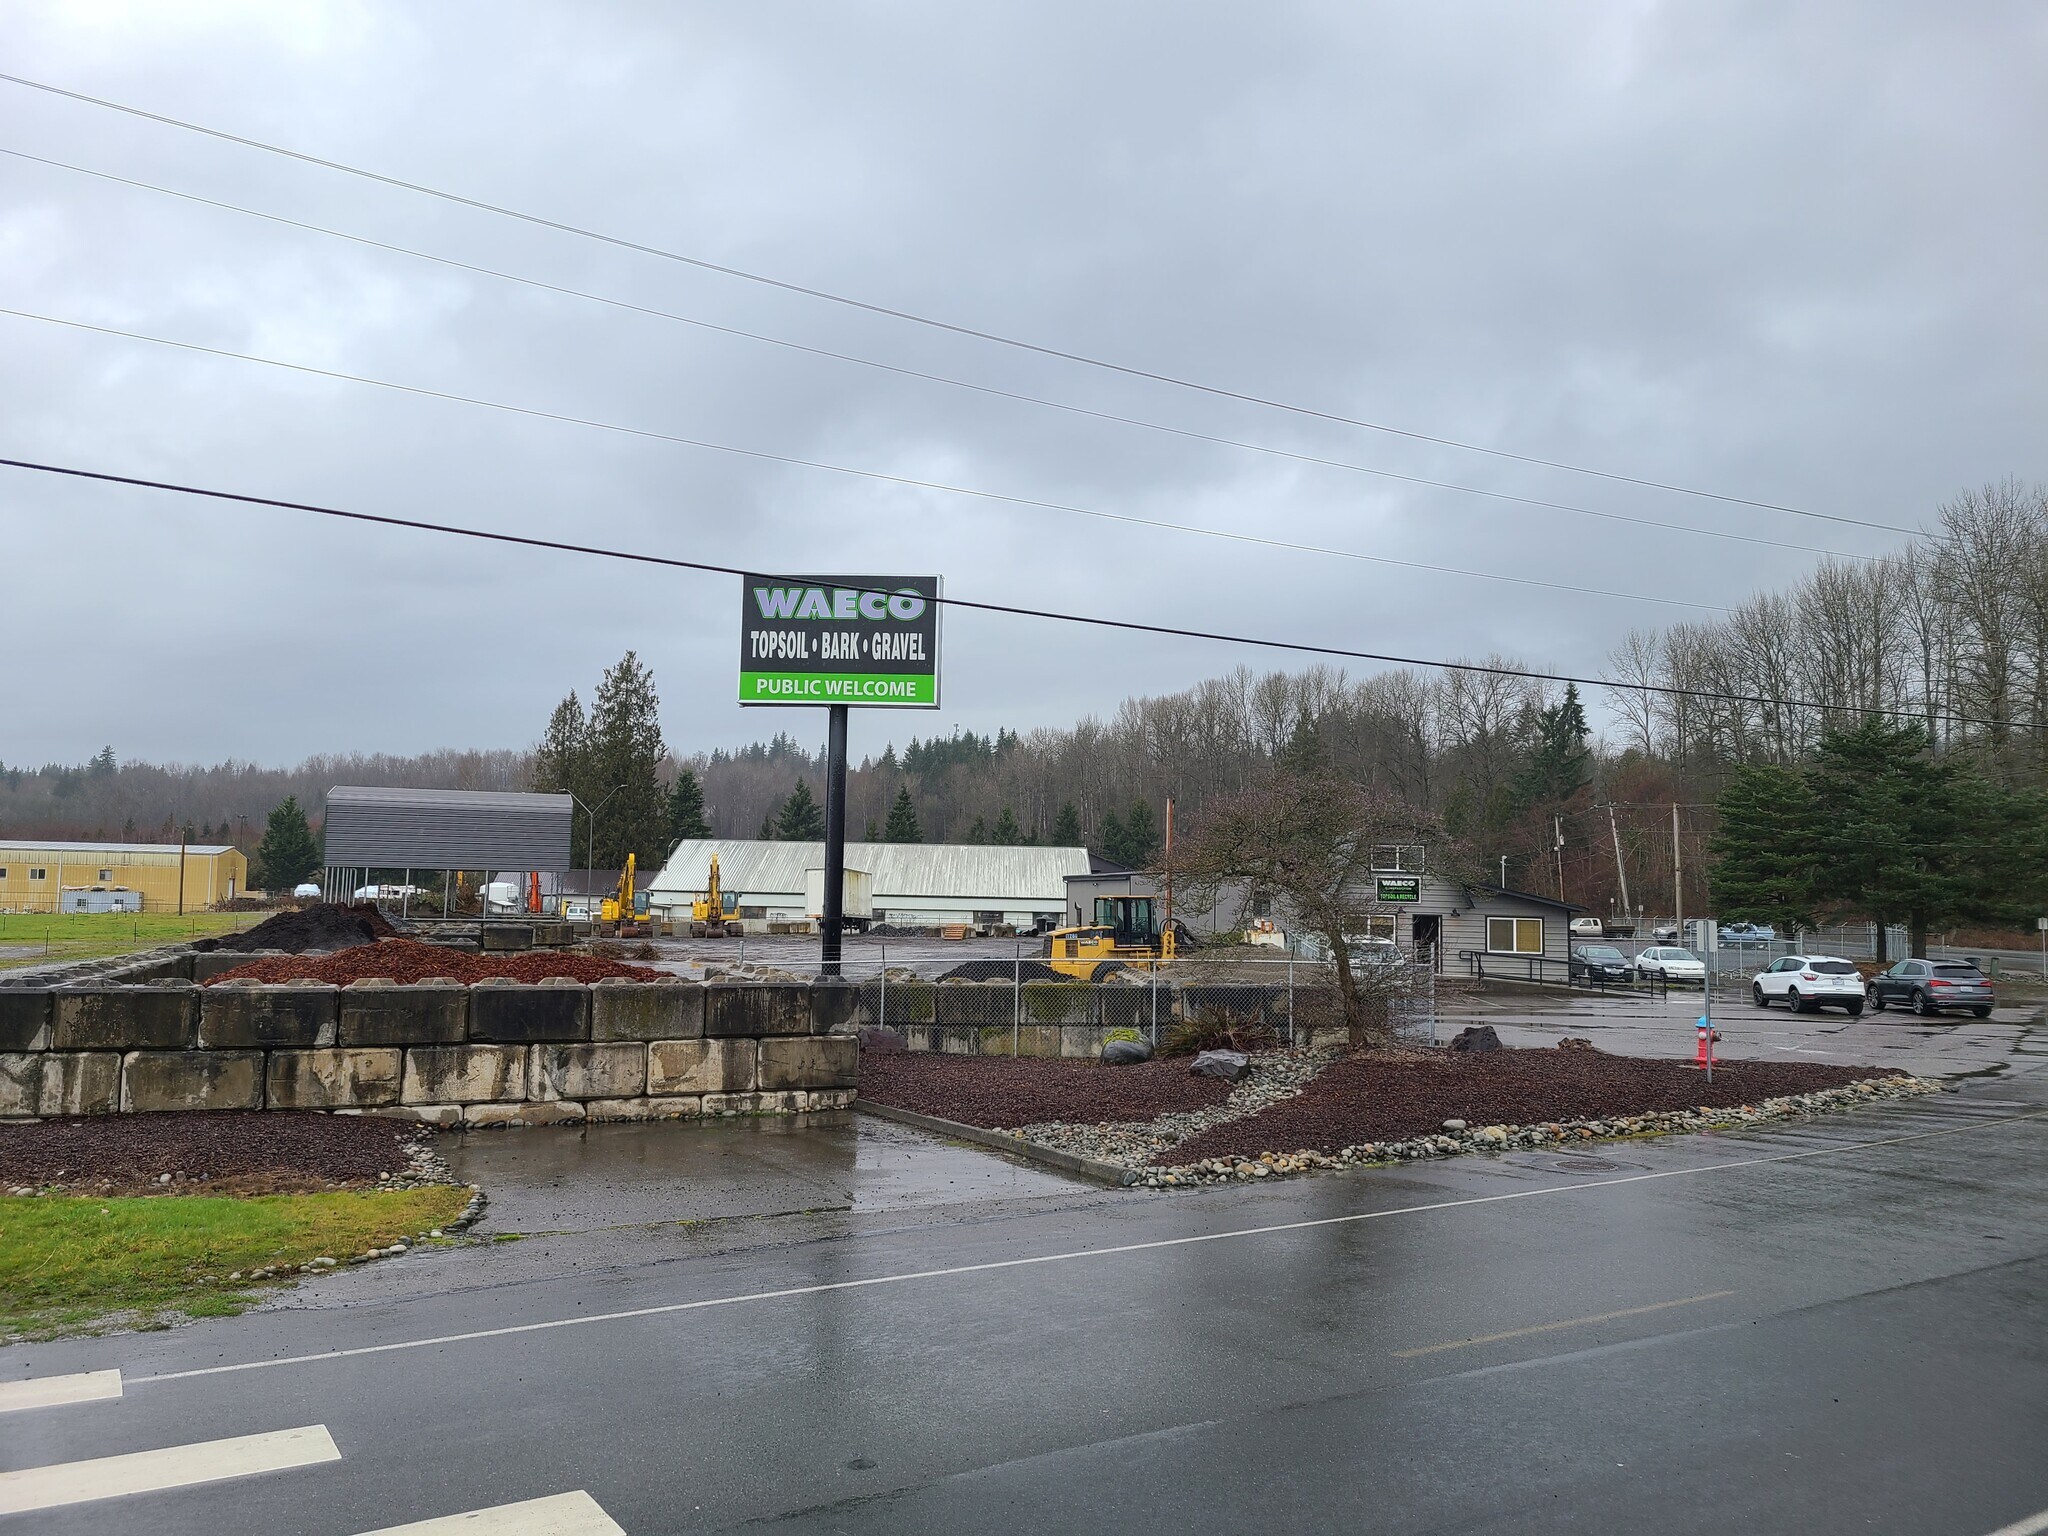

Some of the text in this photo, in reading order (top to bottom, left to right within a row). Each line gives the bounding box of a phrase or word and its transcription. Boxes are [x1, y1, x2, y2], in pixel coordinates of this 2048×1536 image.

[753, 587, 926, 621] WAECO
[750, 630, 926, 661] TOPSOIL BARK GRAVEL
[756, 678, 916, 697] PUBLIC WELCOME
